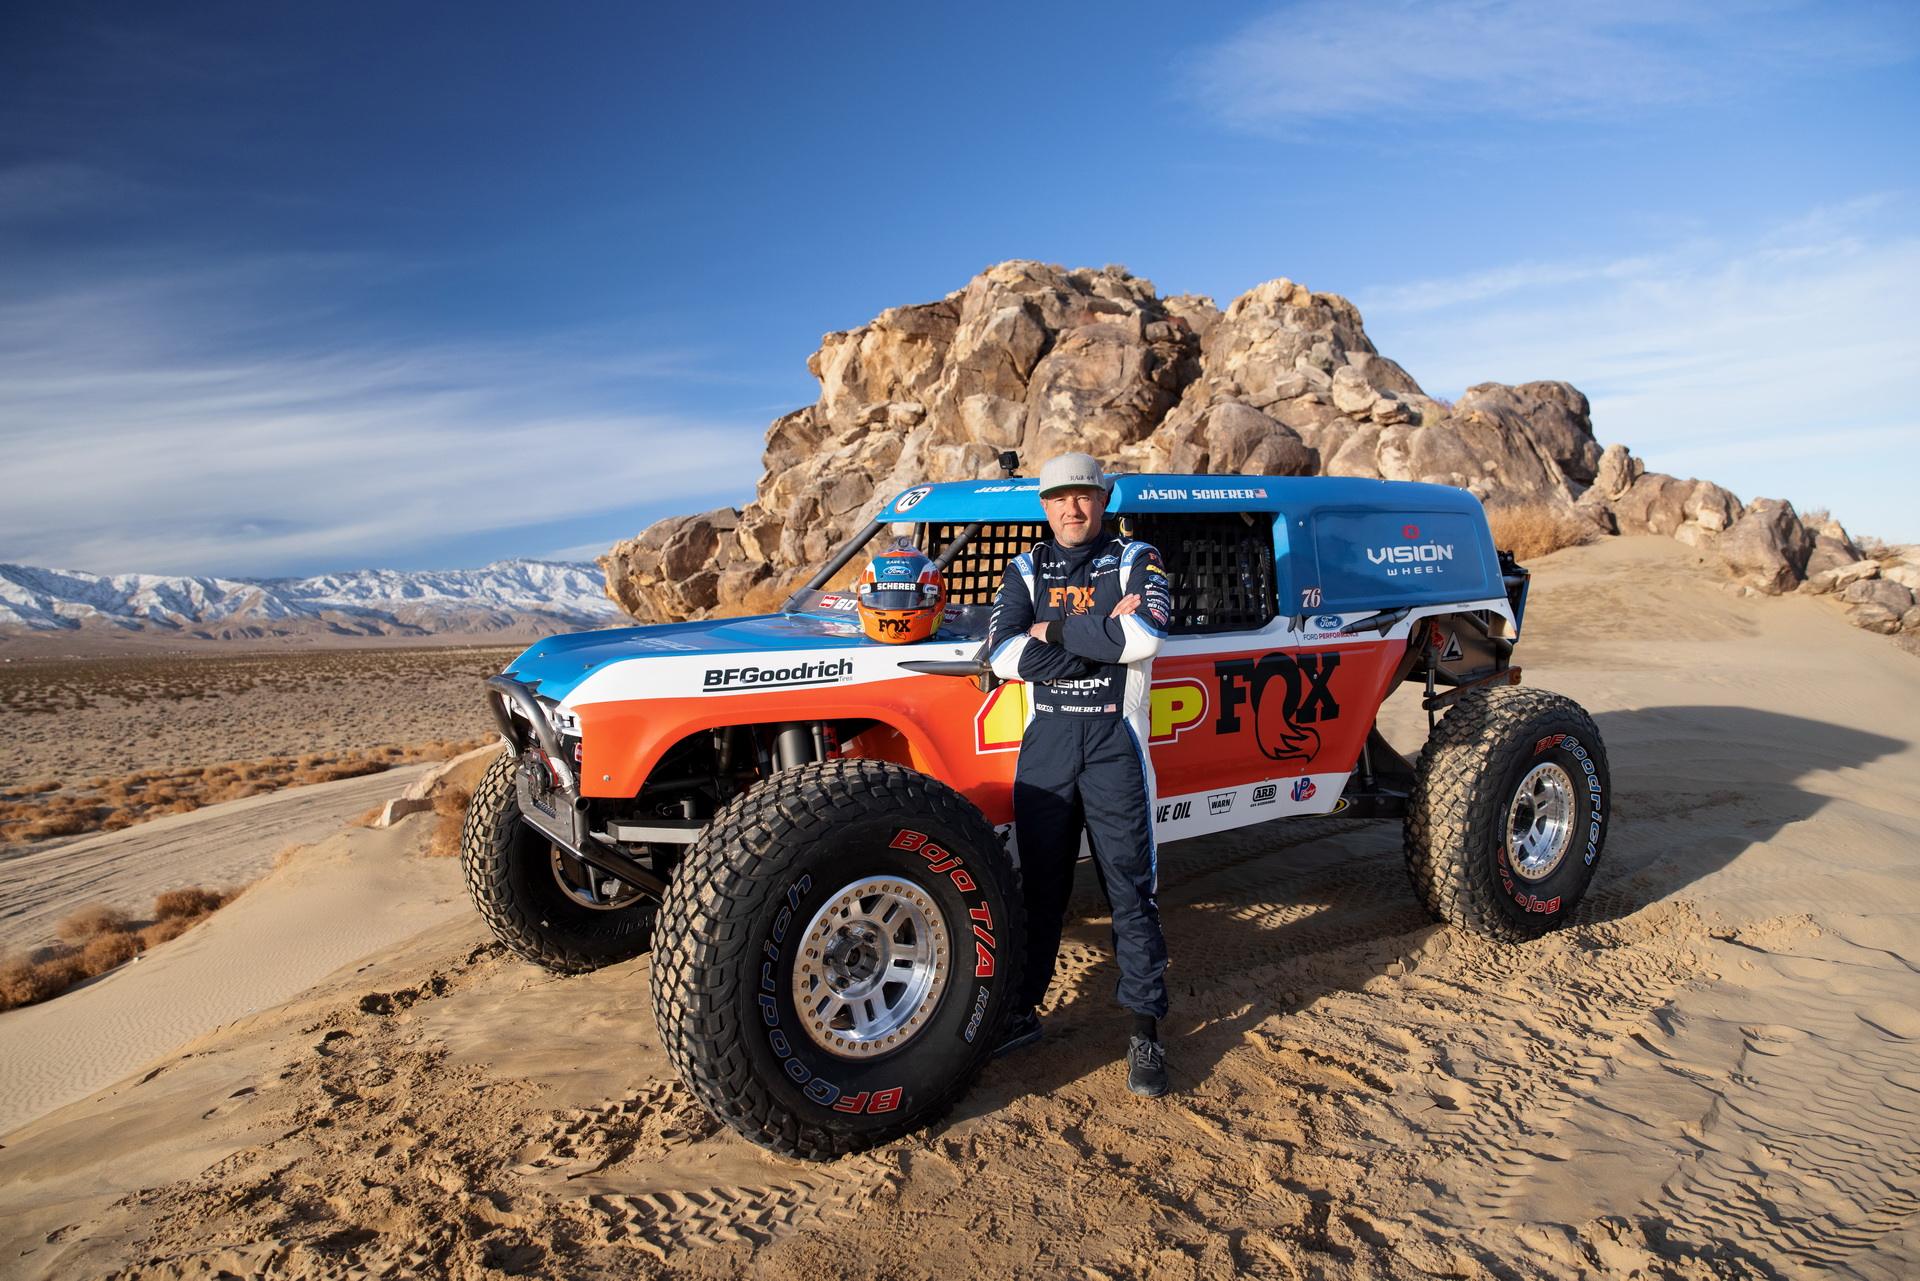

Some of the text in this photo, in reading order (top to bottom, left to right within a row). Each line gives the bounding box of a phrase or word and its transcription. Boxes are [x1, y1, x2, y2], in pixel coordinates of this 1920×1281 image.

[900, 490, 923, 507] 76
[1139, 490, 1254, 500] JASON SCHERER
[1367, 544, 1453, 564] VISION
[886, 566, 906, 575] Ford
[1387, 566, 1444, 576] WHEEL
[877, 582, 916, 590] SCHERER
[1048, 586, 1096, 612] FOX
[1302, 588, 1321, 608] 76
[878, 619, 911, 636] FOX
[1319, 615, 1339, 628] Ford
[704, 658, 853, 686] BFGoodrich
[1061, 704, 1102, 712] SCHERER
[1214, 652, 1341, 753] FOX
[1255, 788, 1274, 799] ARB
[1294, 777, 1310, 802] VP
[1211, 798, 1230, 810] WARN
[1534, 734, 1602, 866] BFGoodrich
[1172, 801, 1192, 820] OIL
[1498, 846, 1517, 895] T/A
[1515, 892, 1561, 914] Baja
[889, 829, 996, 1043] Baja T/A KR3
[758, 874, 903, 1114] BFGoodrich
